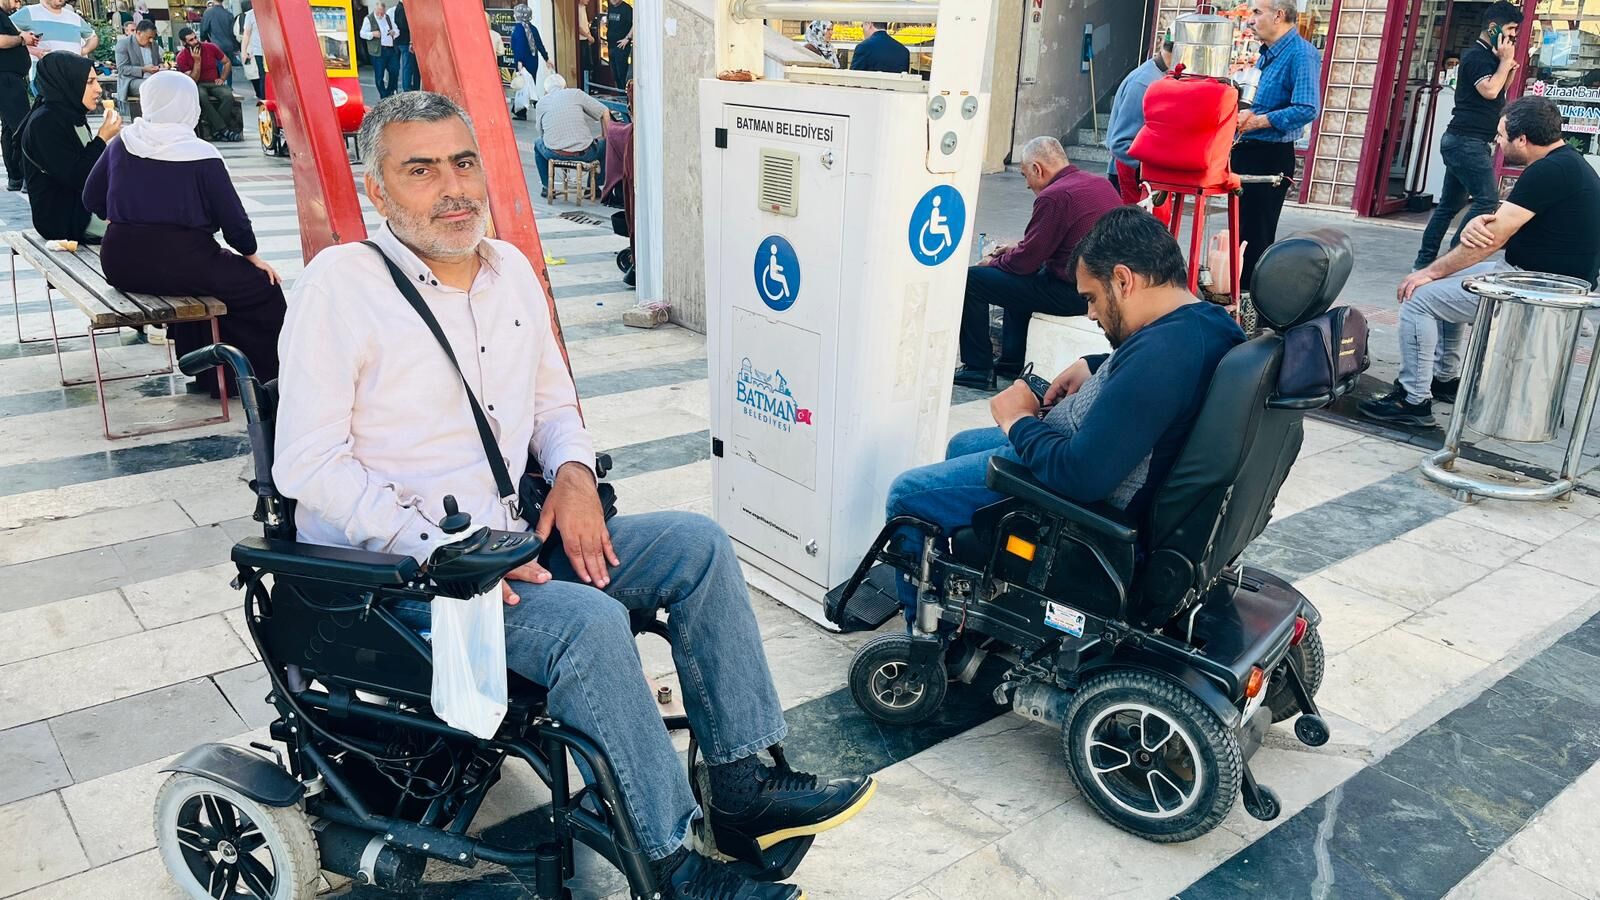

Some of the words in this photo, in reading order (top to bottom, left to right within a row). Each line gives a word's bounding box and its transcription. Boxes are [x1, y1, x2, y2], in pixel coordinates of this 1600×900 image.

[1546, 86, 1576, 97] Ziraat
[736, 116, 774, 133] BATMAN
[776, 121, 833, 142] BELEDİYESİ
[736, 380, 798, 425] BATMAN
[743, 406, 791, 433] BELEDİYESİ
